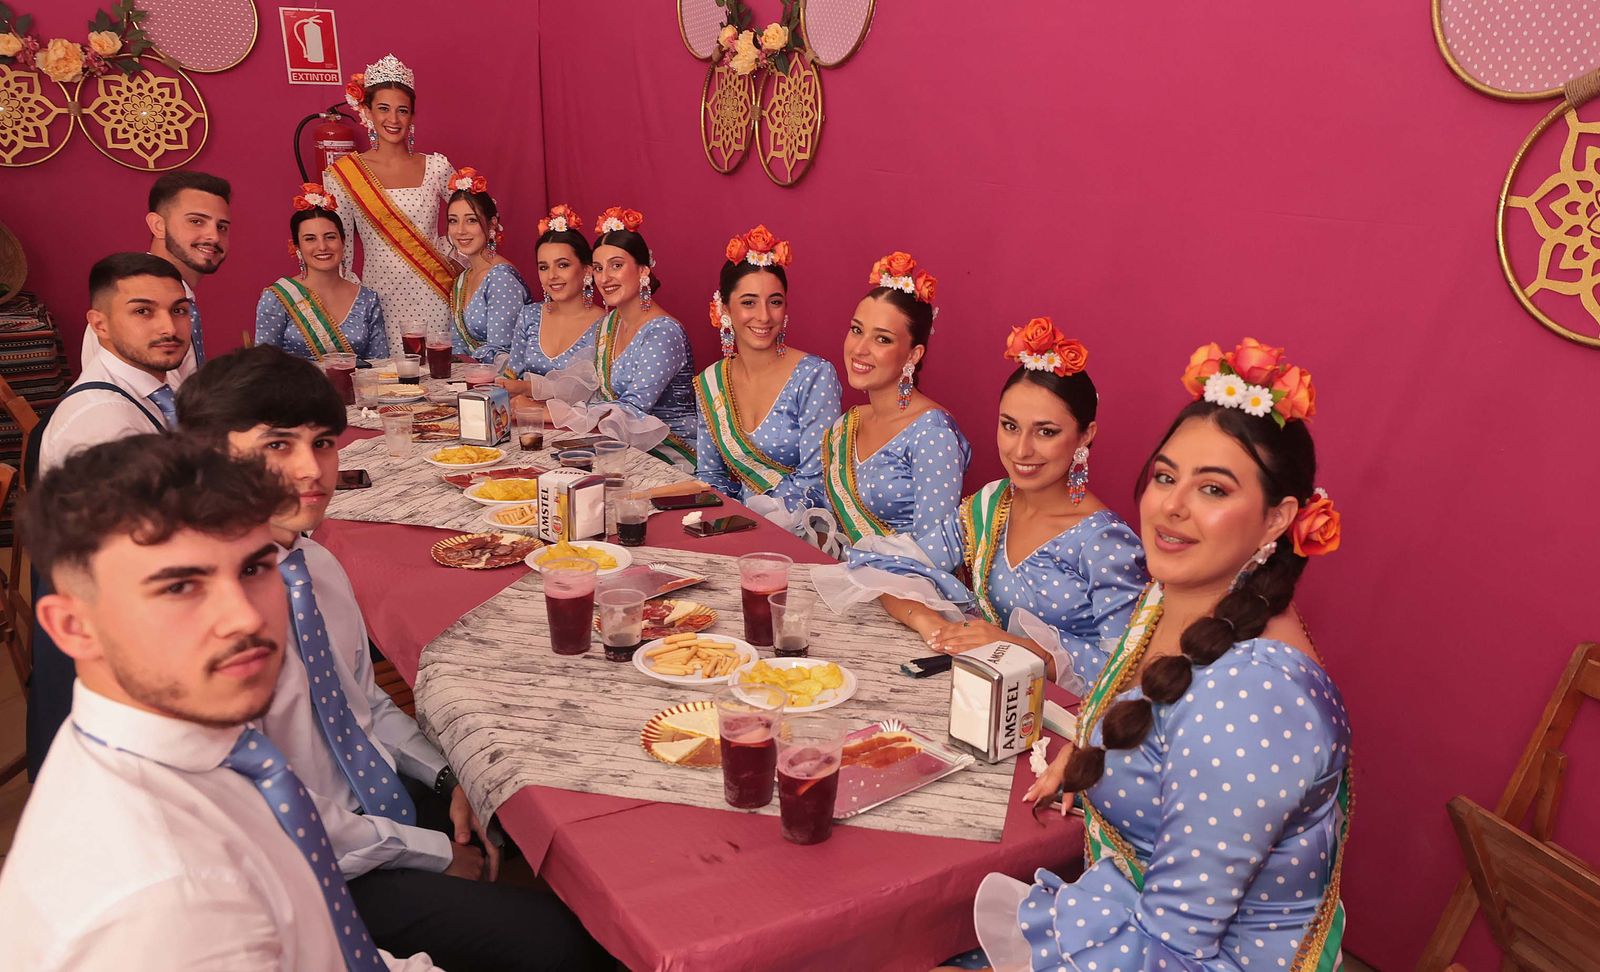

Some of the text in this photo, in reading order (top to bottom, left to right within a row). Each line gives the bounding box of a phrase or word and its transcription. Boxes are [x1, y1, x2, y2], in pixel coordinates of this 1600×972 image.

[292, 72, 338, 82] EXTINTOR
[541, 487, 549, 537] AMSTEL
[987, 643, 1011, 665] AMSTEL
[1003, 681, 1020, 750] AMSTEL
